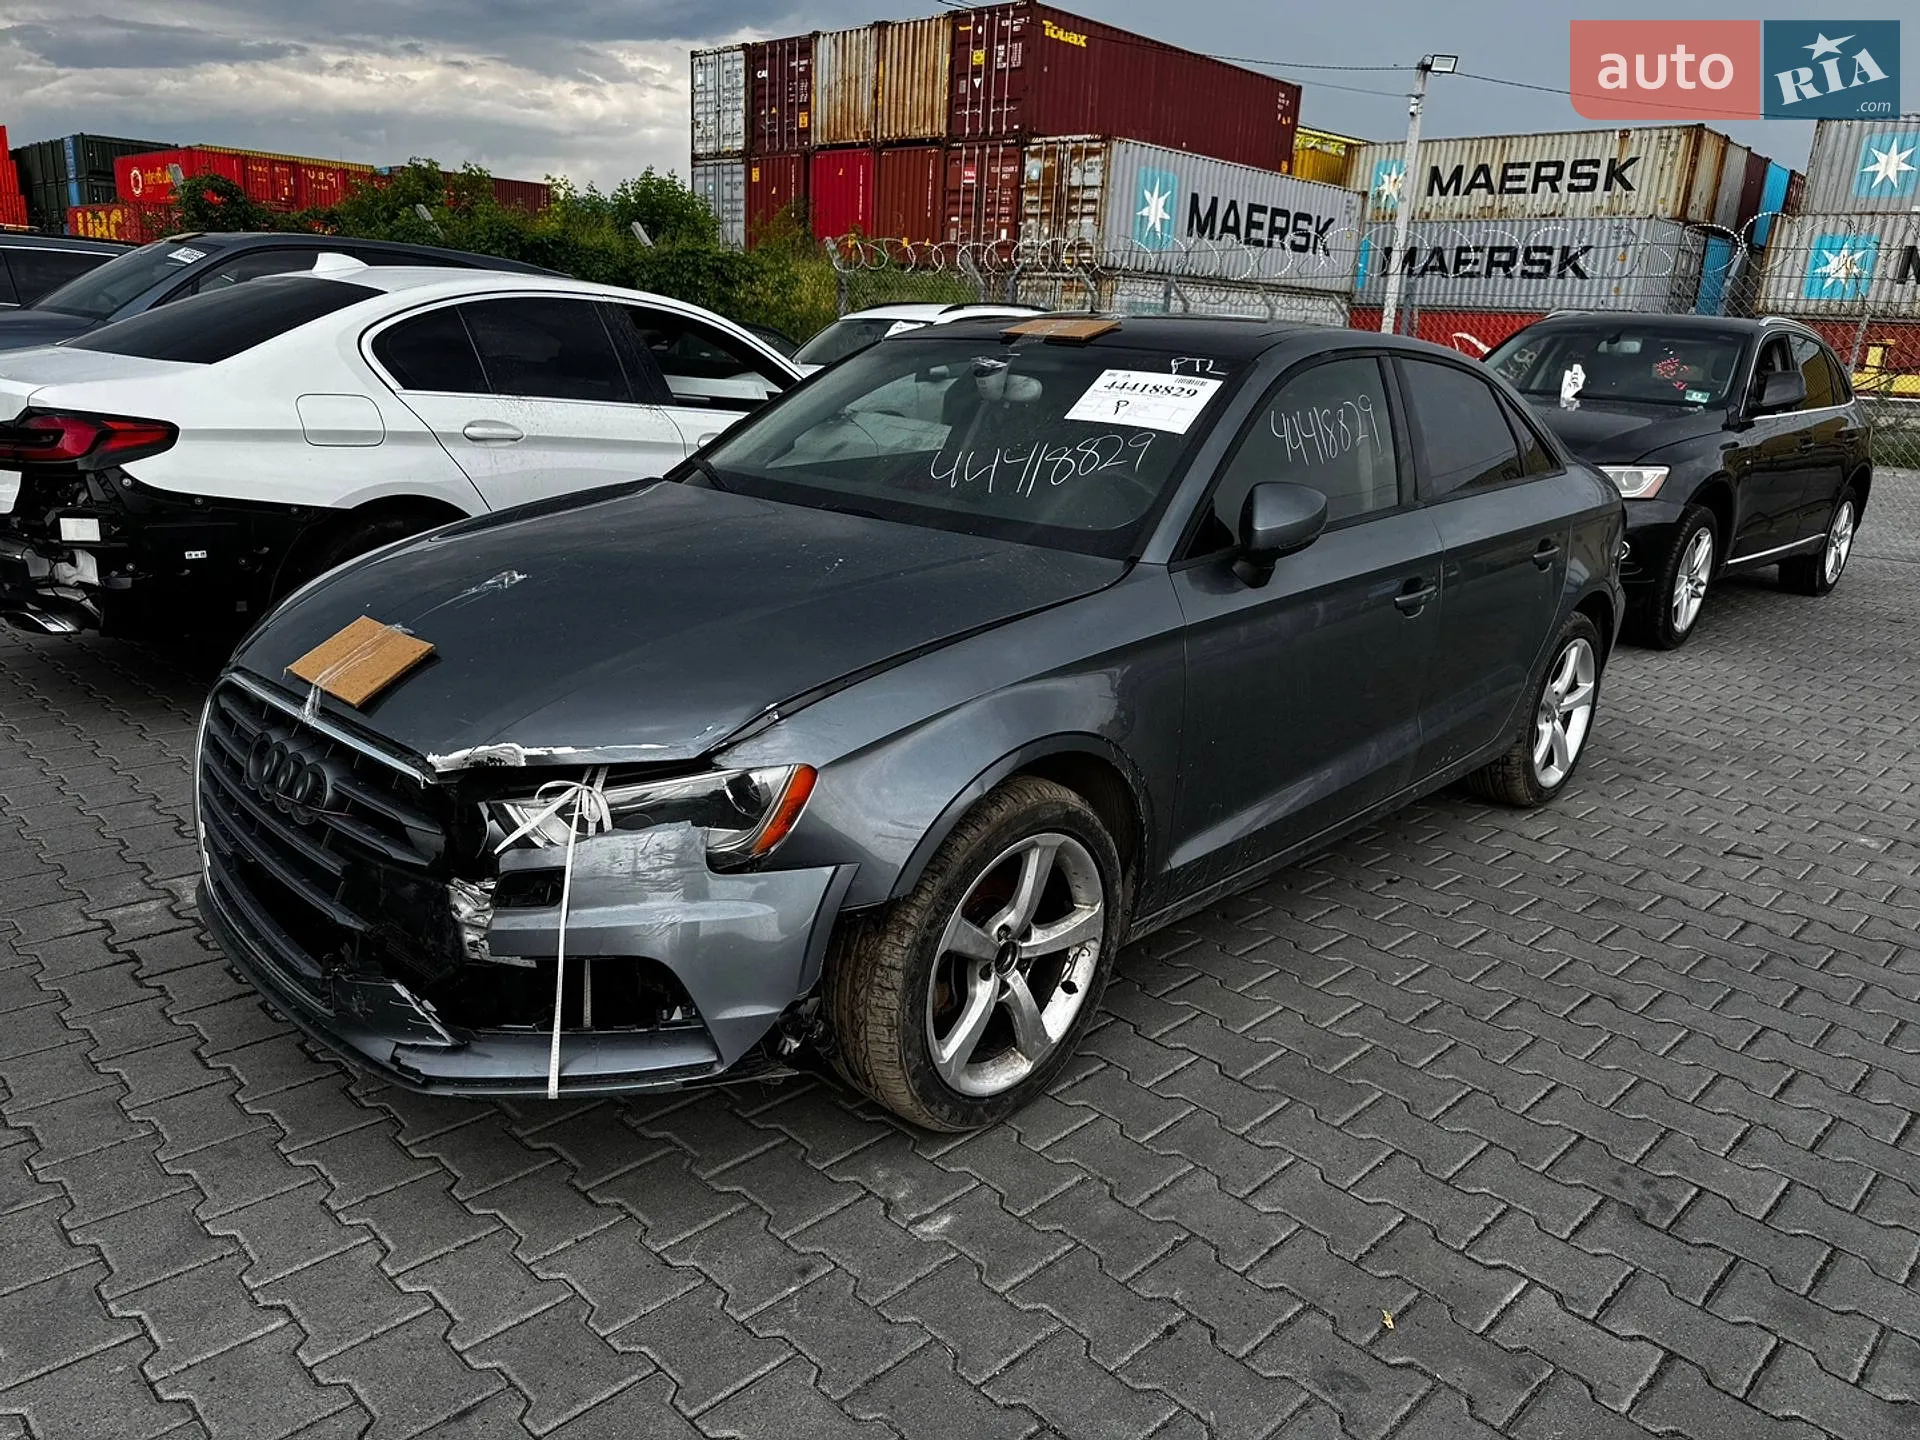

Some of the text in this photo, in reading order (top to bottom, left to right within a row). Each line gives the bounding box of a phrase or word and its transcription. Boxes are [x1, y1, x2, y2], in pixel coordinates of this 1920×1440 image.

[1042, 20, 1088, 48] Touax
[1426, 156, 1641, 197] MAERSK
[1187, 192, 1335, 257] MAERSK
[1379, 244, 1593, 280] MAERSK
[1103, 380, 1198, 399] 44418829
[1270, 394, 1382, 467] 44418829
[930, 431, 1157, 499] 44418829
